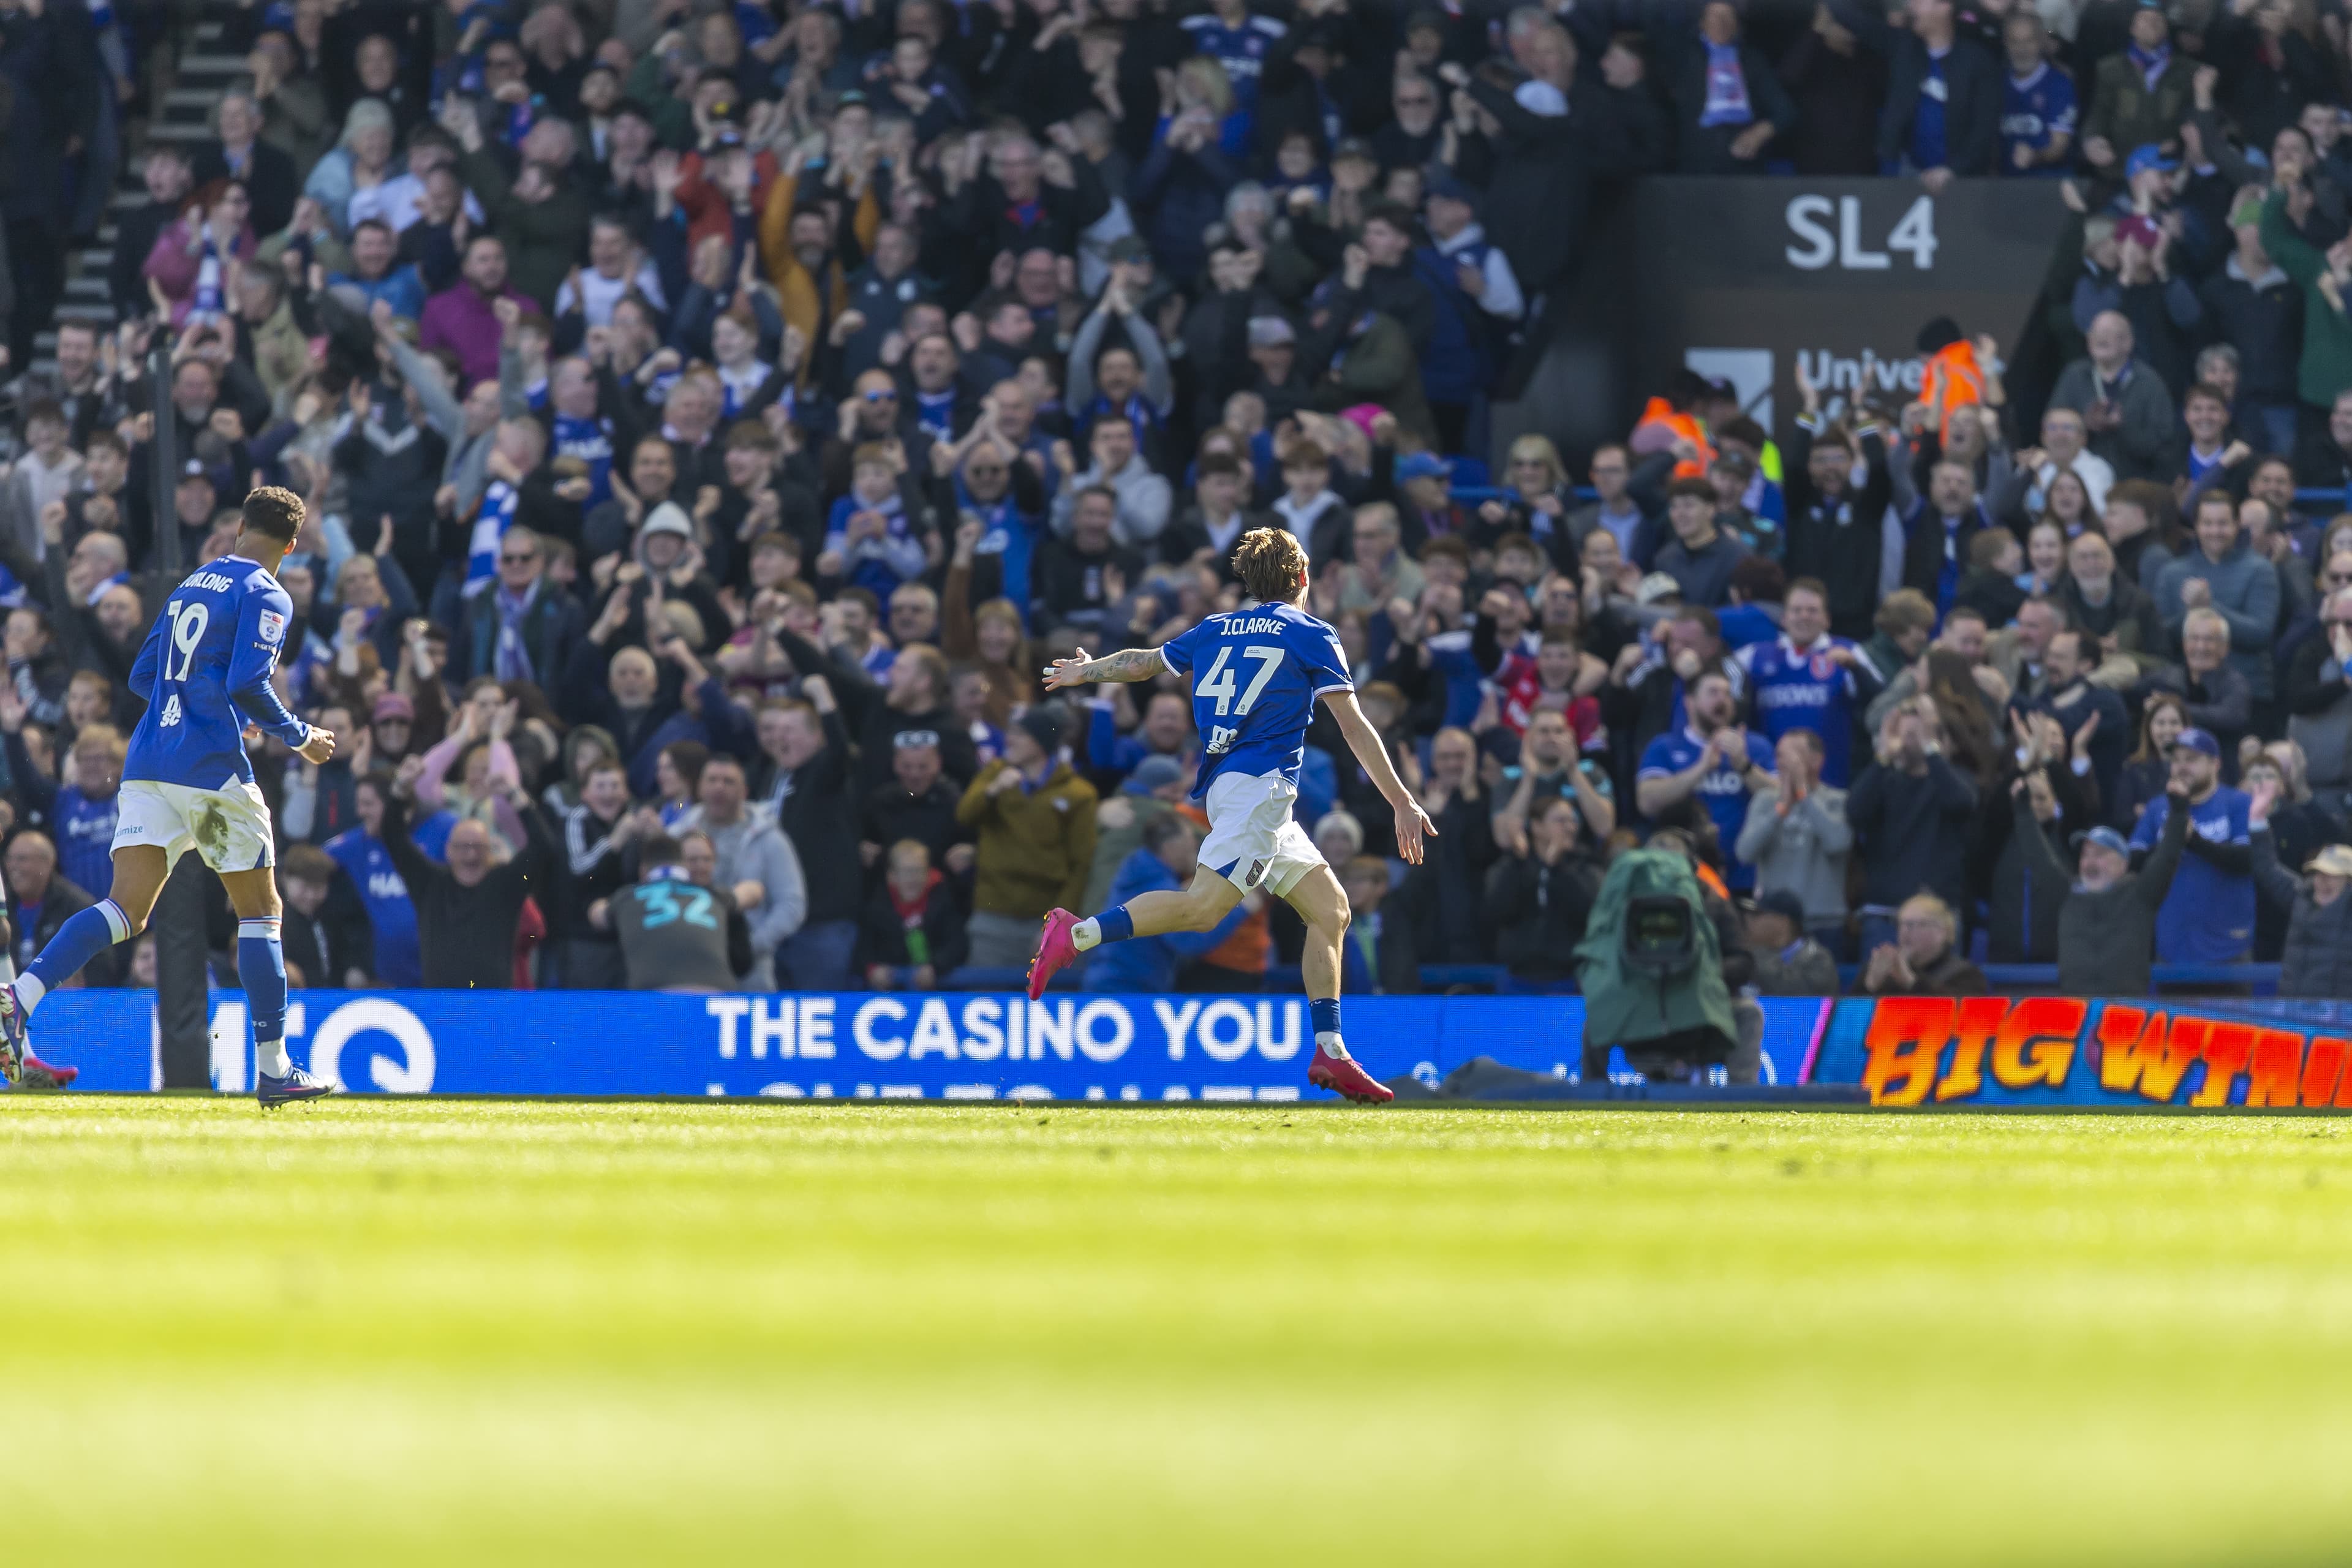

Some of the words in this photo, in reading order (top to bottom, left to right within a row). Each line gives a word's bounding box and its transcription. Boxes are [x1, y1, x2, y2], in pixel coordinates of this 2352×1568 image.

[1785, 194, 1939, 270] SL4
[1796, 348, 1924, 393] Unive
[164, 600, 209, 682] 19
[1220, 617, 1287, 636] J.CLARKE
[1195, 646, 1285, 715] 47
[633, 880, 718, 932] 32
[706, 996, 837, 1060] THE
[852, 997, 1135, 1062] CASINO
[1152, 998, 1302, 1061] YOU
[1862, 997, 2088, 1107] BIG
